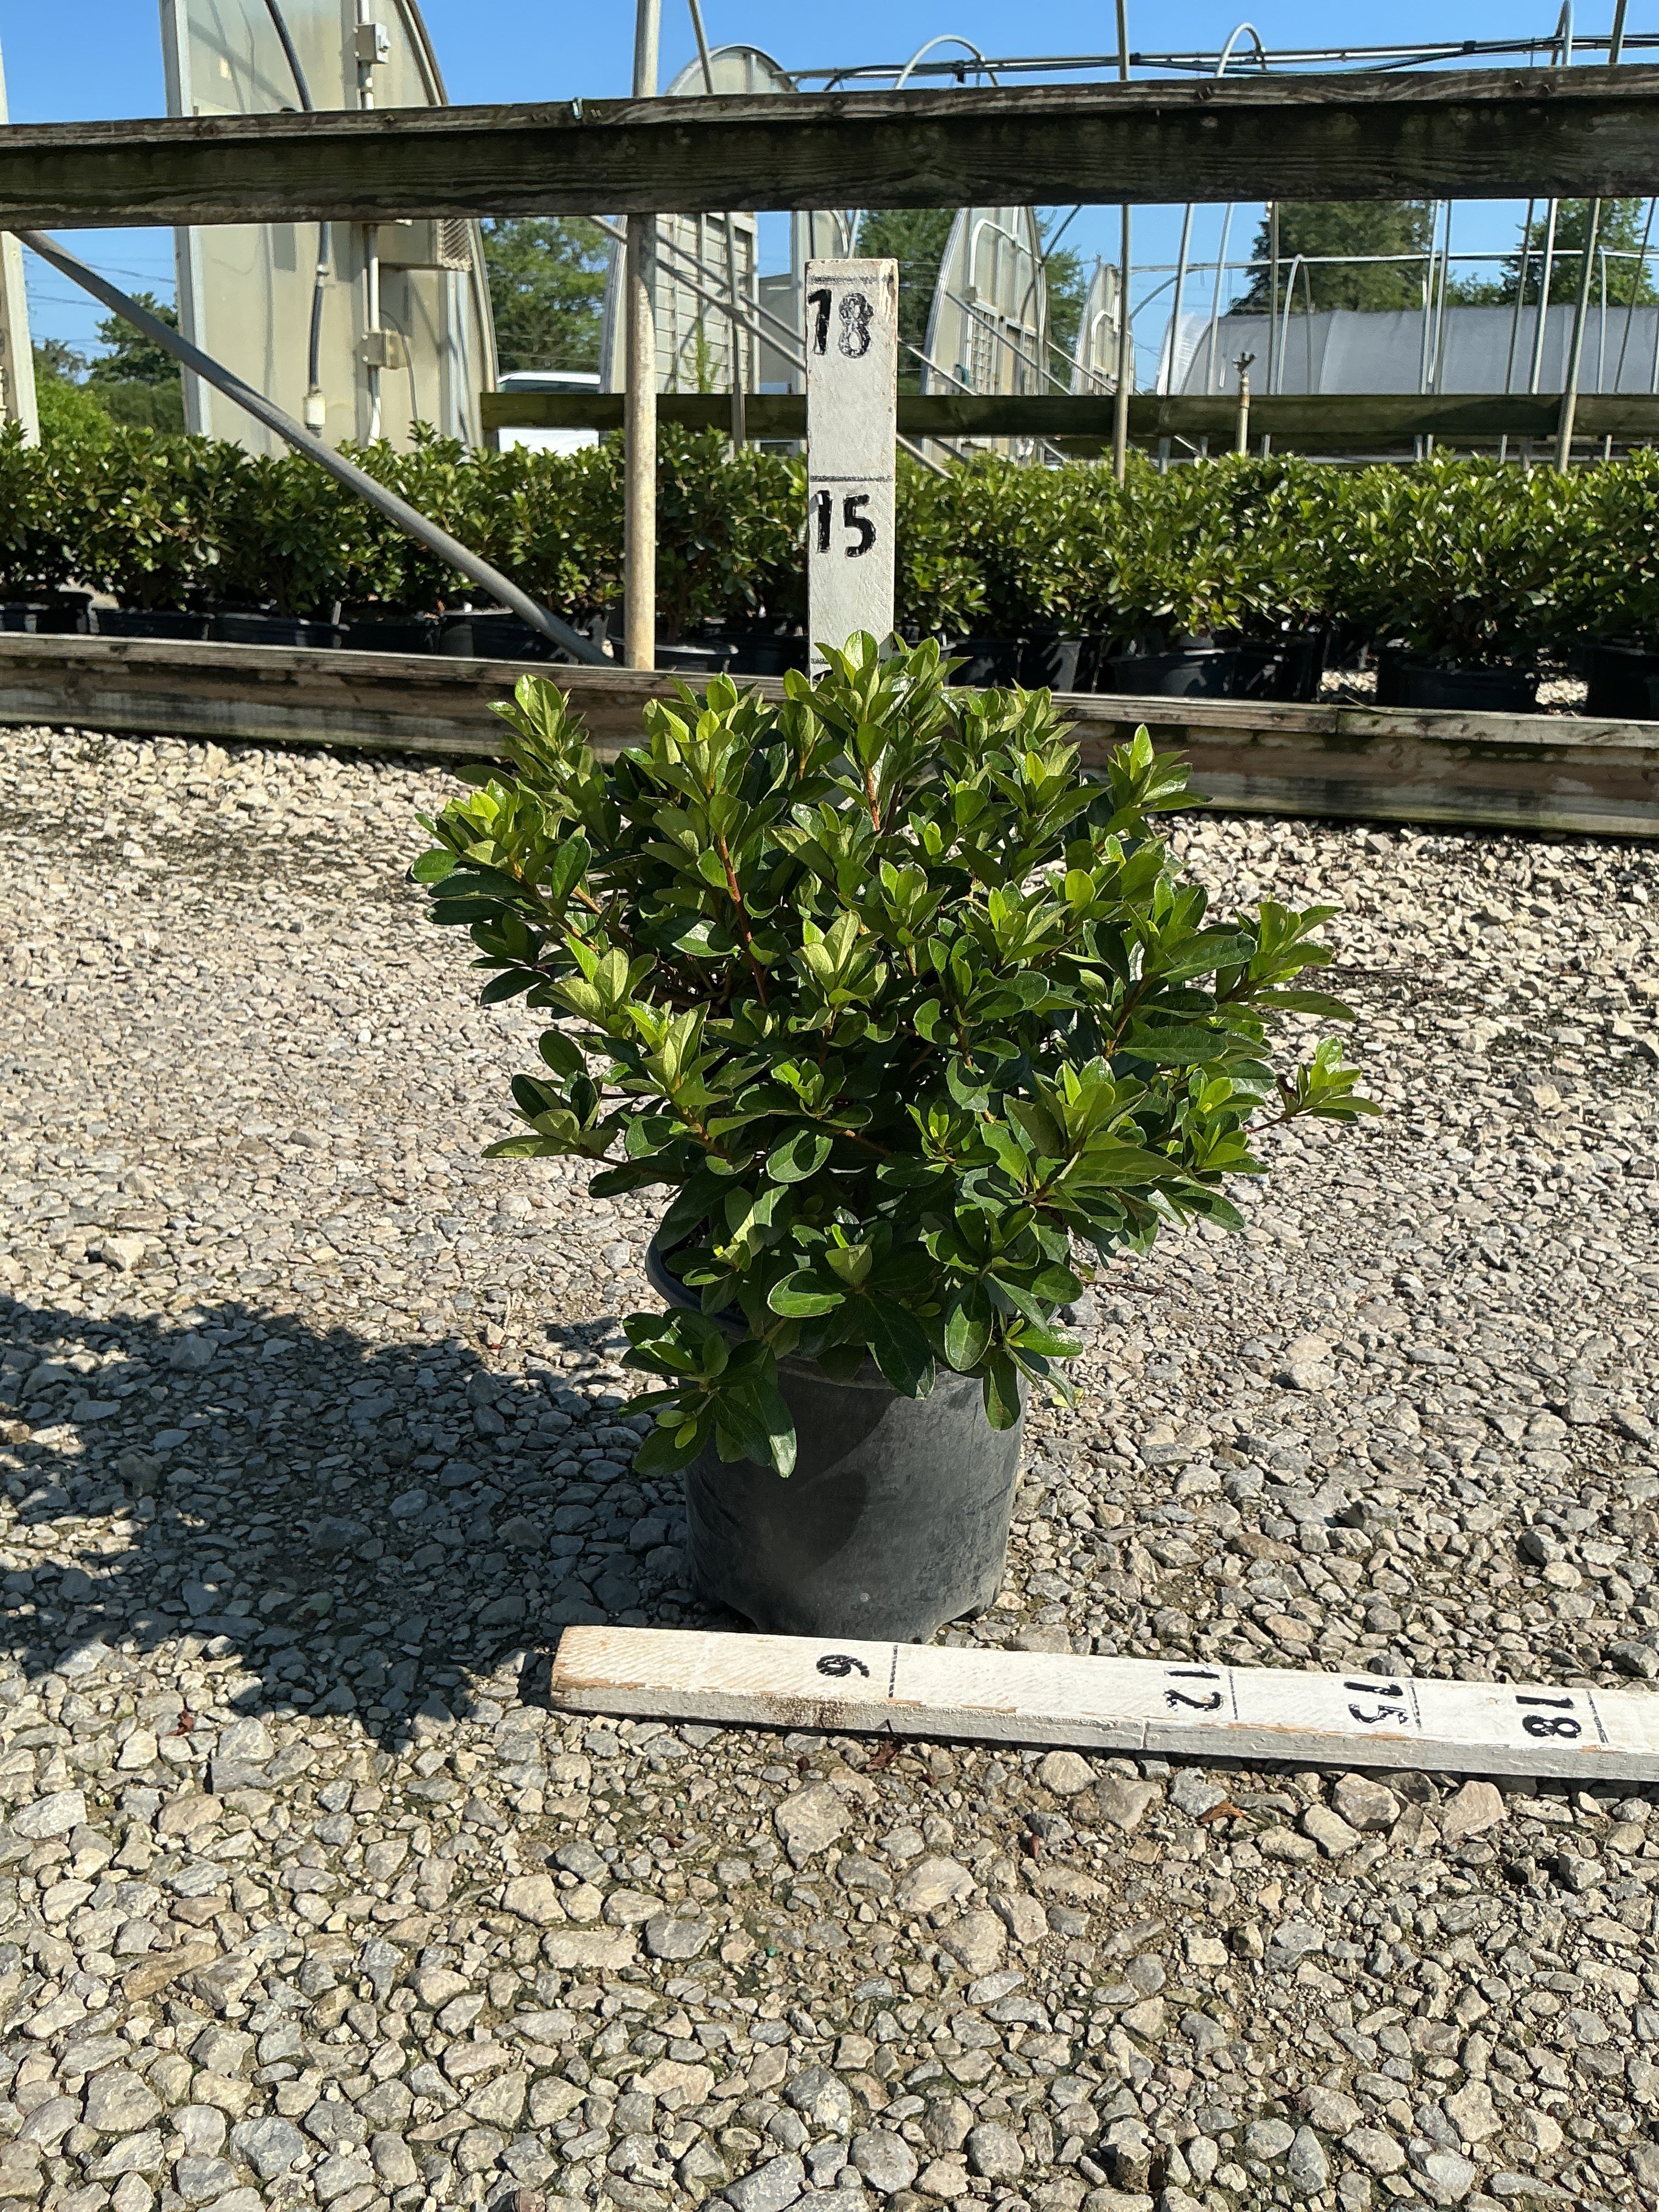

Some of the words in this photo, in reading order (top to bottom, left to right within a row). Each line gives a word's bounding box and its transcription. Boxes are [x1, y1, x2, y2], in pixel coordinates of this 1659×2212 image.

[808, 289, 874, 358] 18
[810, 489, 877, 558] 15
[815, 1654, 870, 1679] 6
[1164, 1669, 1224, 1712] 12
[1342, 1680, 1409, 1726] 15
[1515, 1695, 1582, 1740] 18
